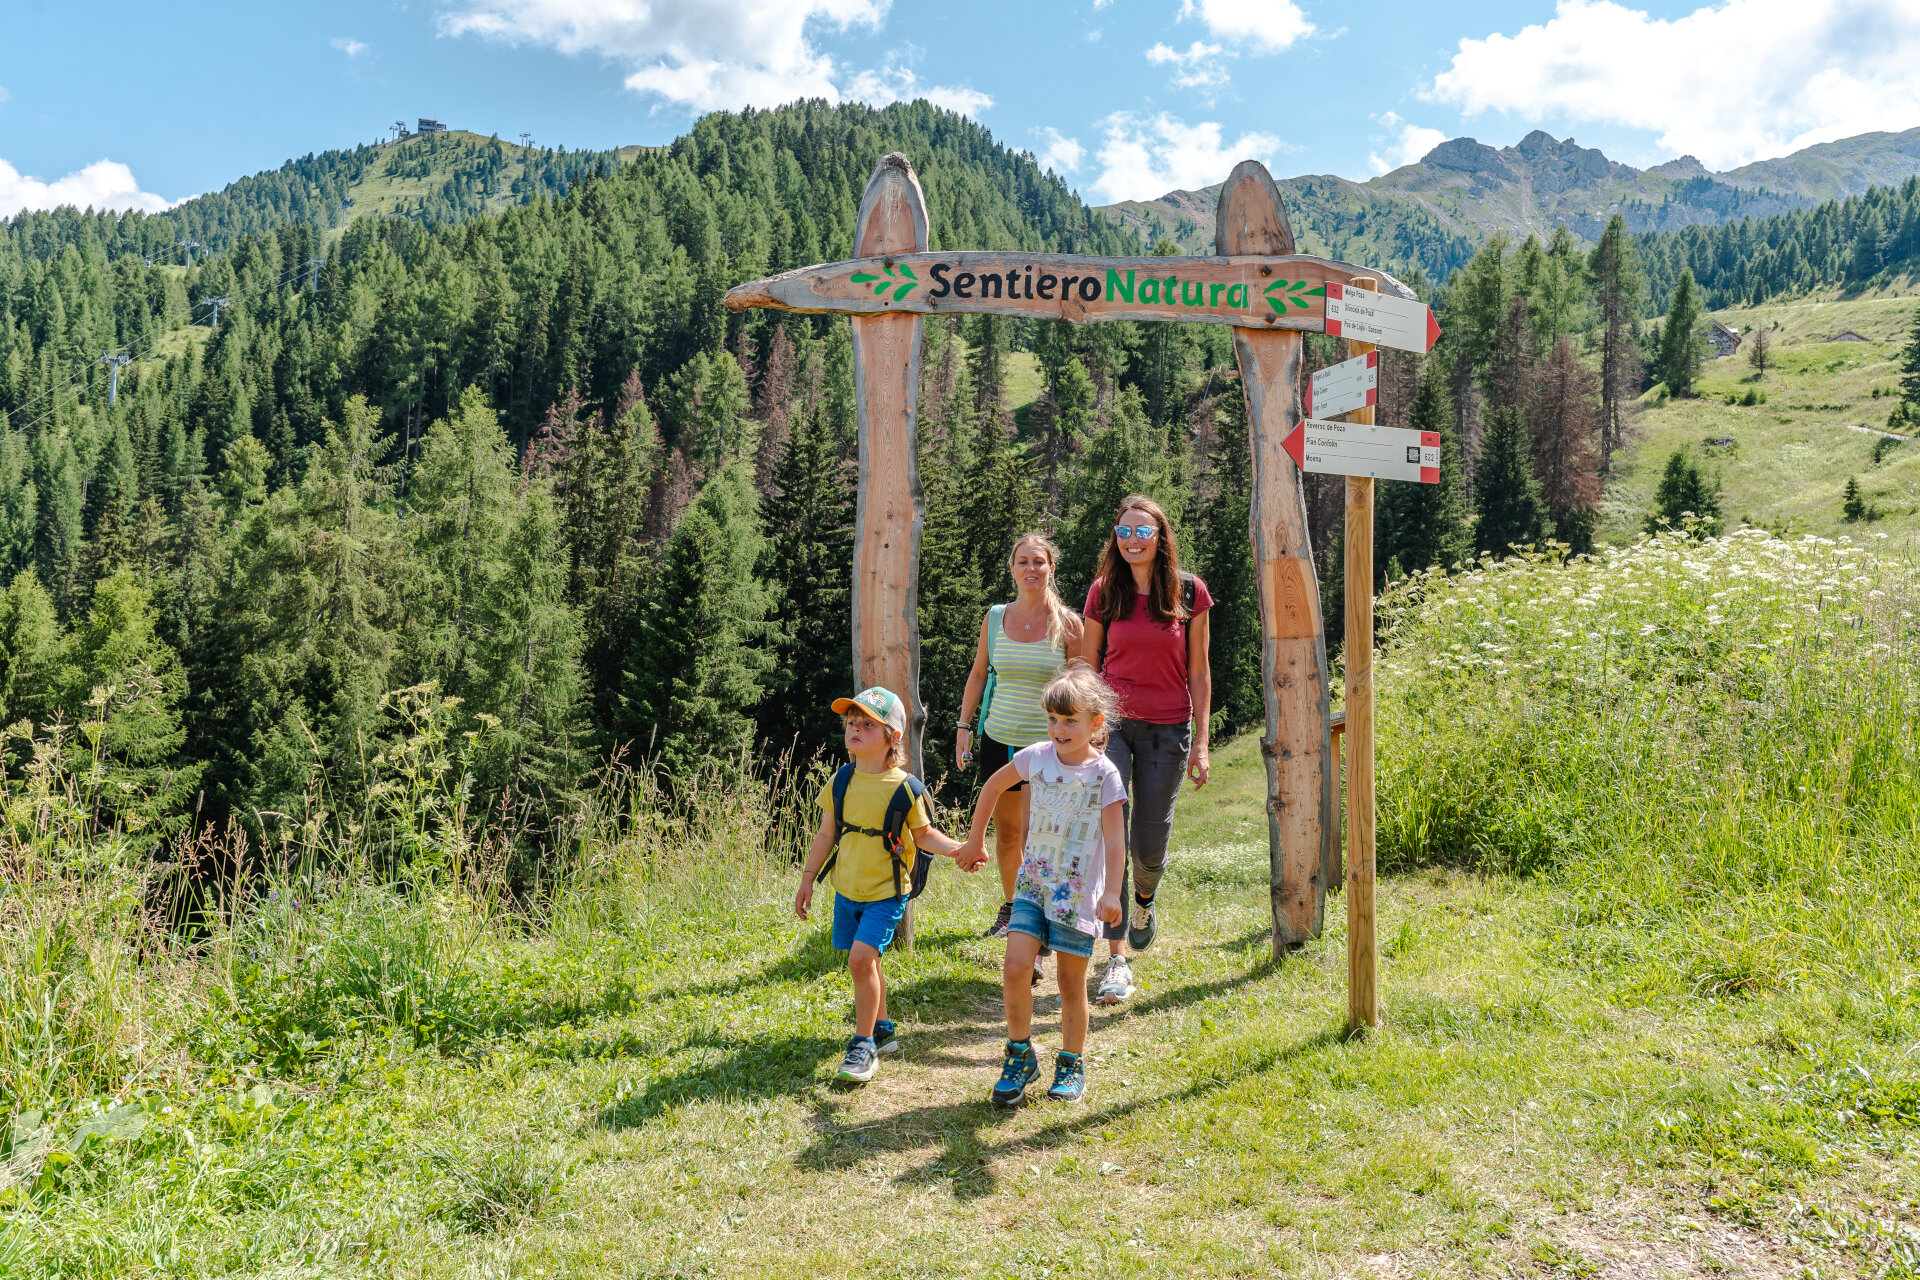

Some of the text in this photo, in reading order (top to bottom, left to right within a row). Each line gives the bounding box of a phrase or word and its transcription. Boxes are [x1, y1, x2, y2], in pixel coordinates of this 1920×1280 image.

[1333, 424, 1345, 432] Poza
[1306, 437, 1317, 446] Plan
[1305, 454, 1322, 463] Moena
[1424, 453, 1434, 462] 622
